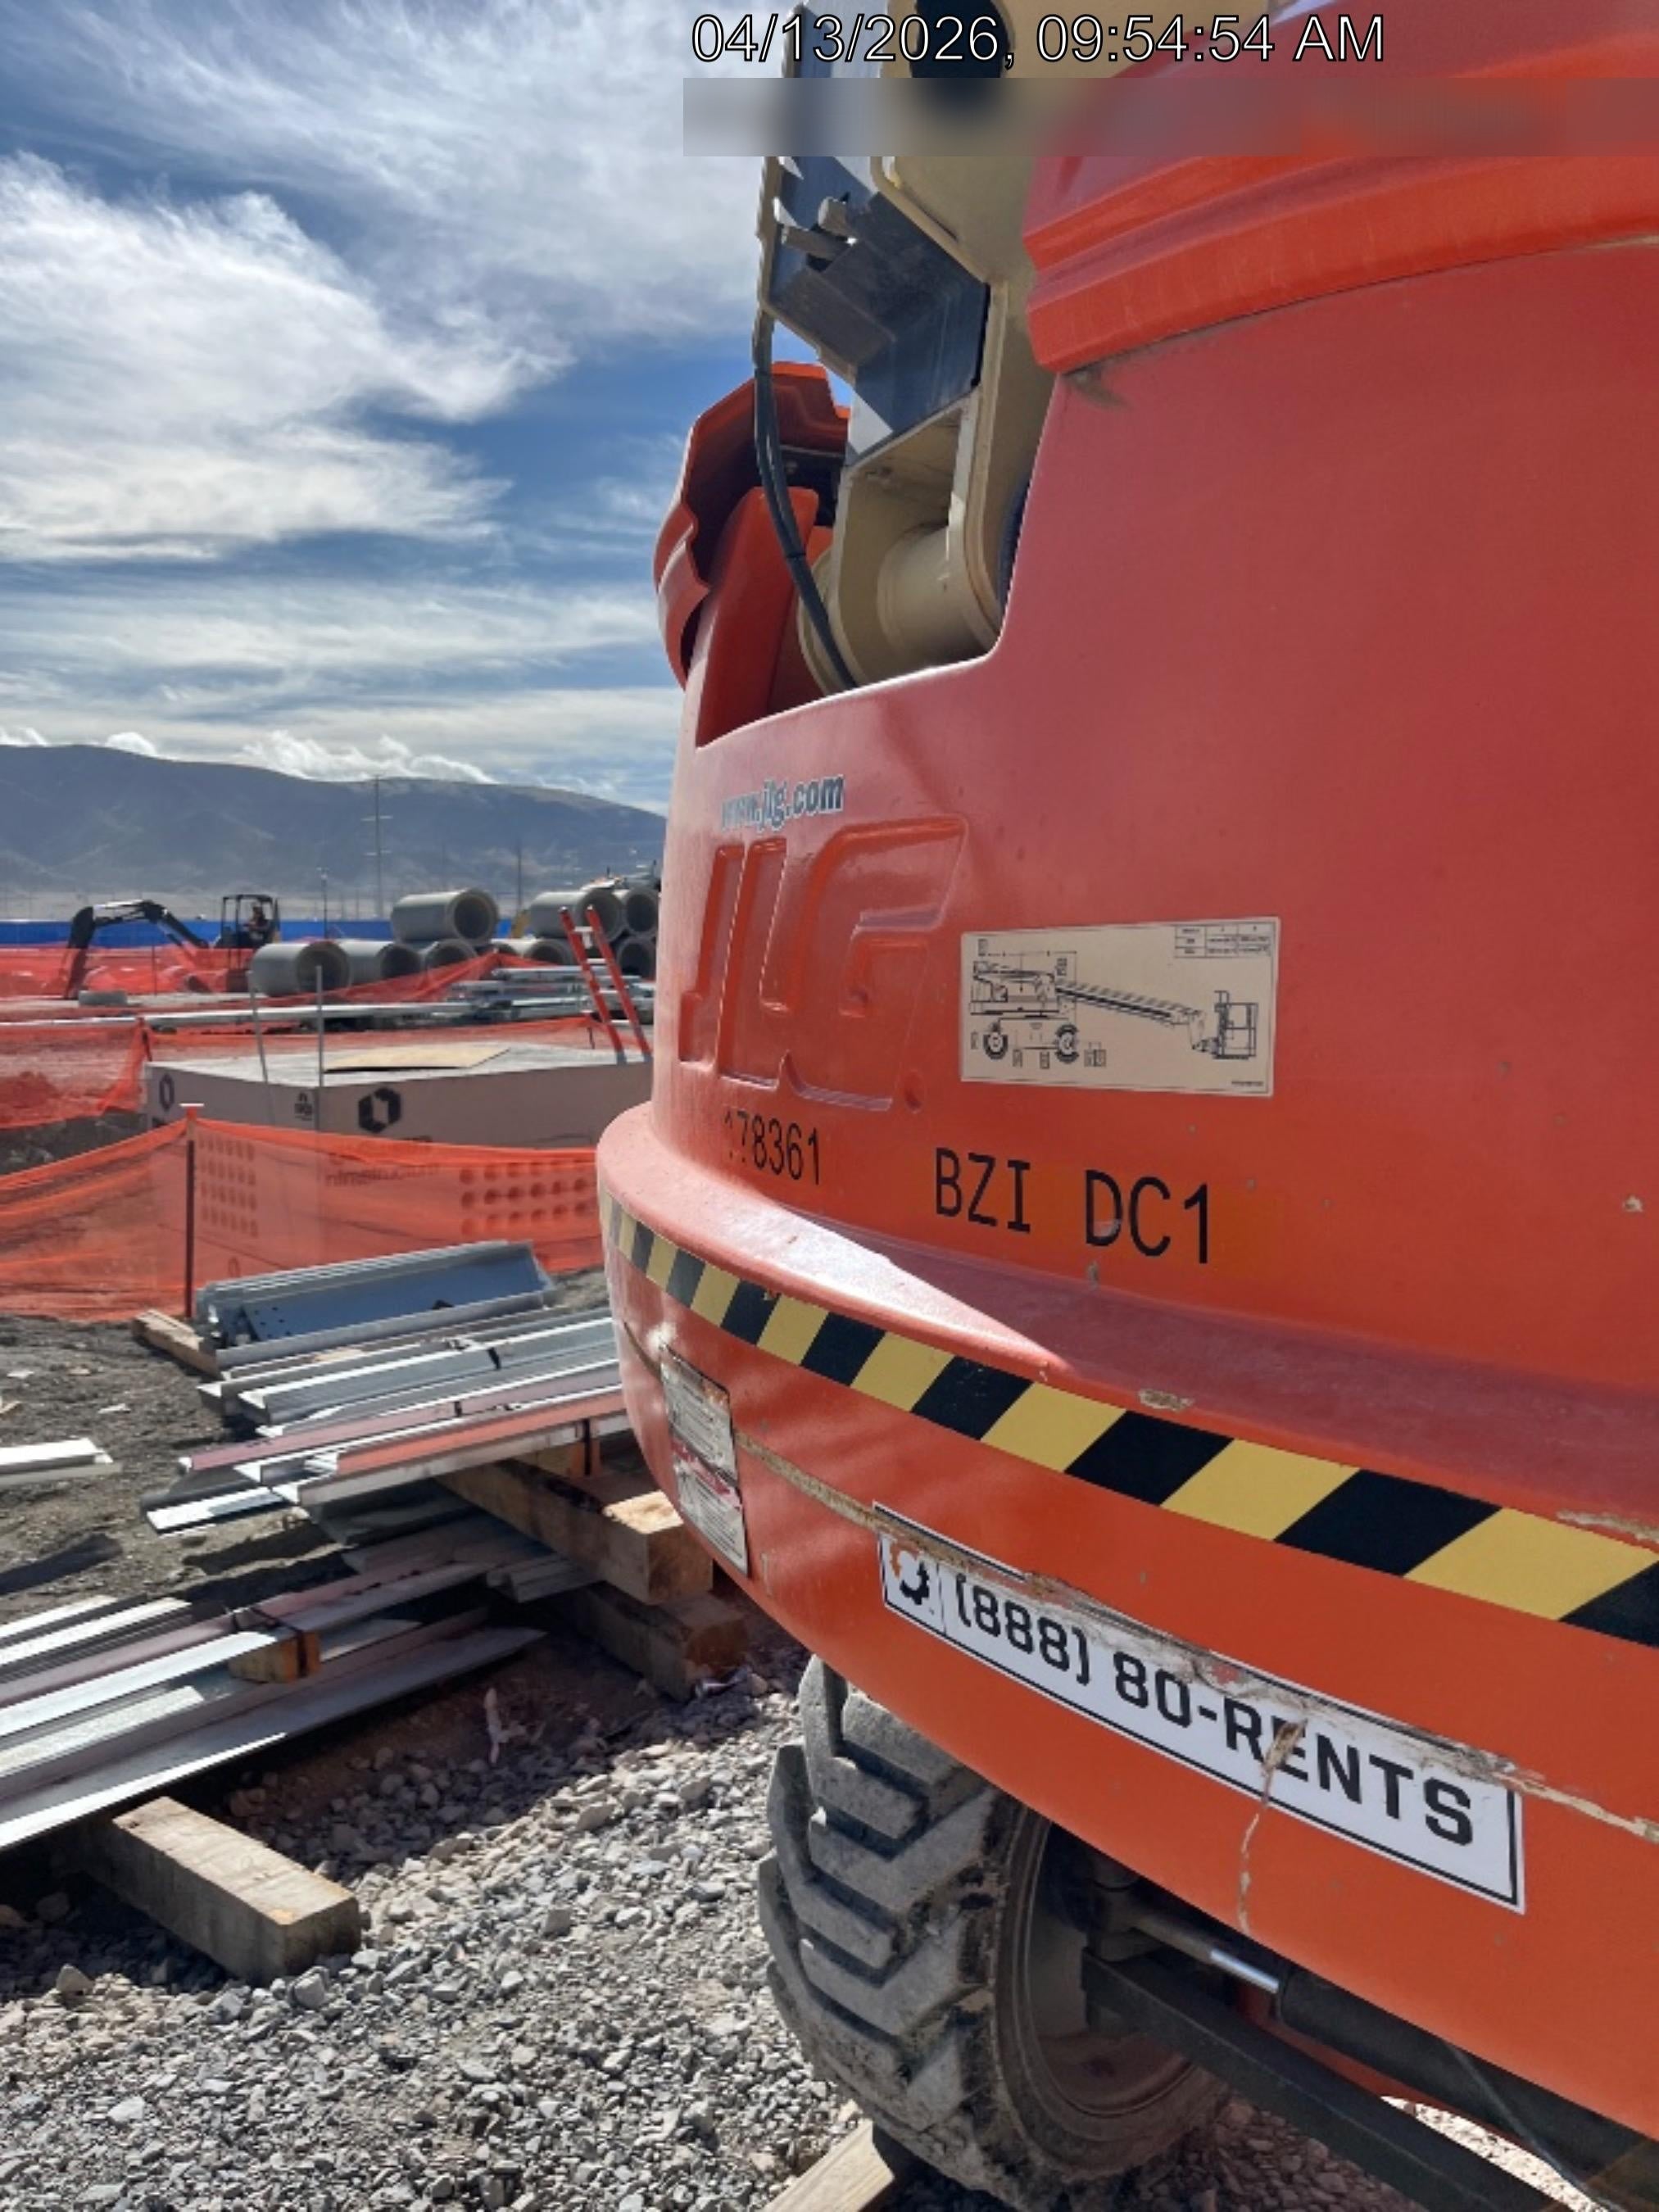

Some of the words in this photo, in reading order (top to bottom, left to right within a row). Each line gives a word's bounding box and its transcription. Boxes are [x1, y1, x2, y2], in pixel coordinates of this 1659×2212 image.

[936, 1147, 1031, 1233] BZI
[1085, 1169, 1208, 1264] DC1
[954, 1574, 1090, 1685] (888)
[1113, 1651, 1474, 1847] 80-RENTS
